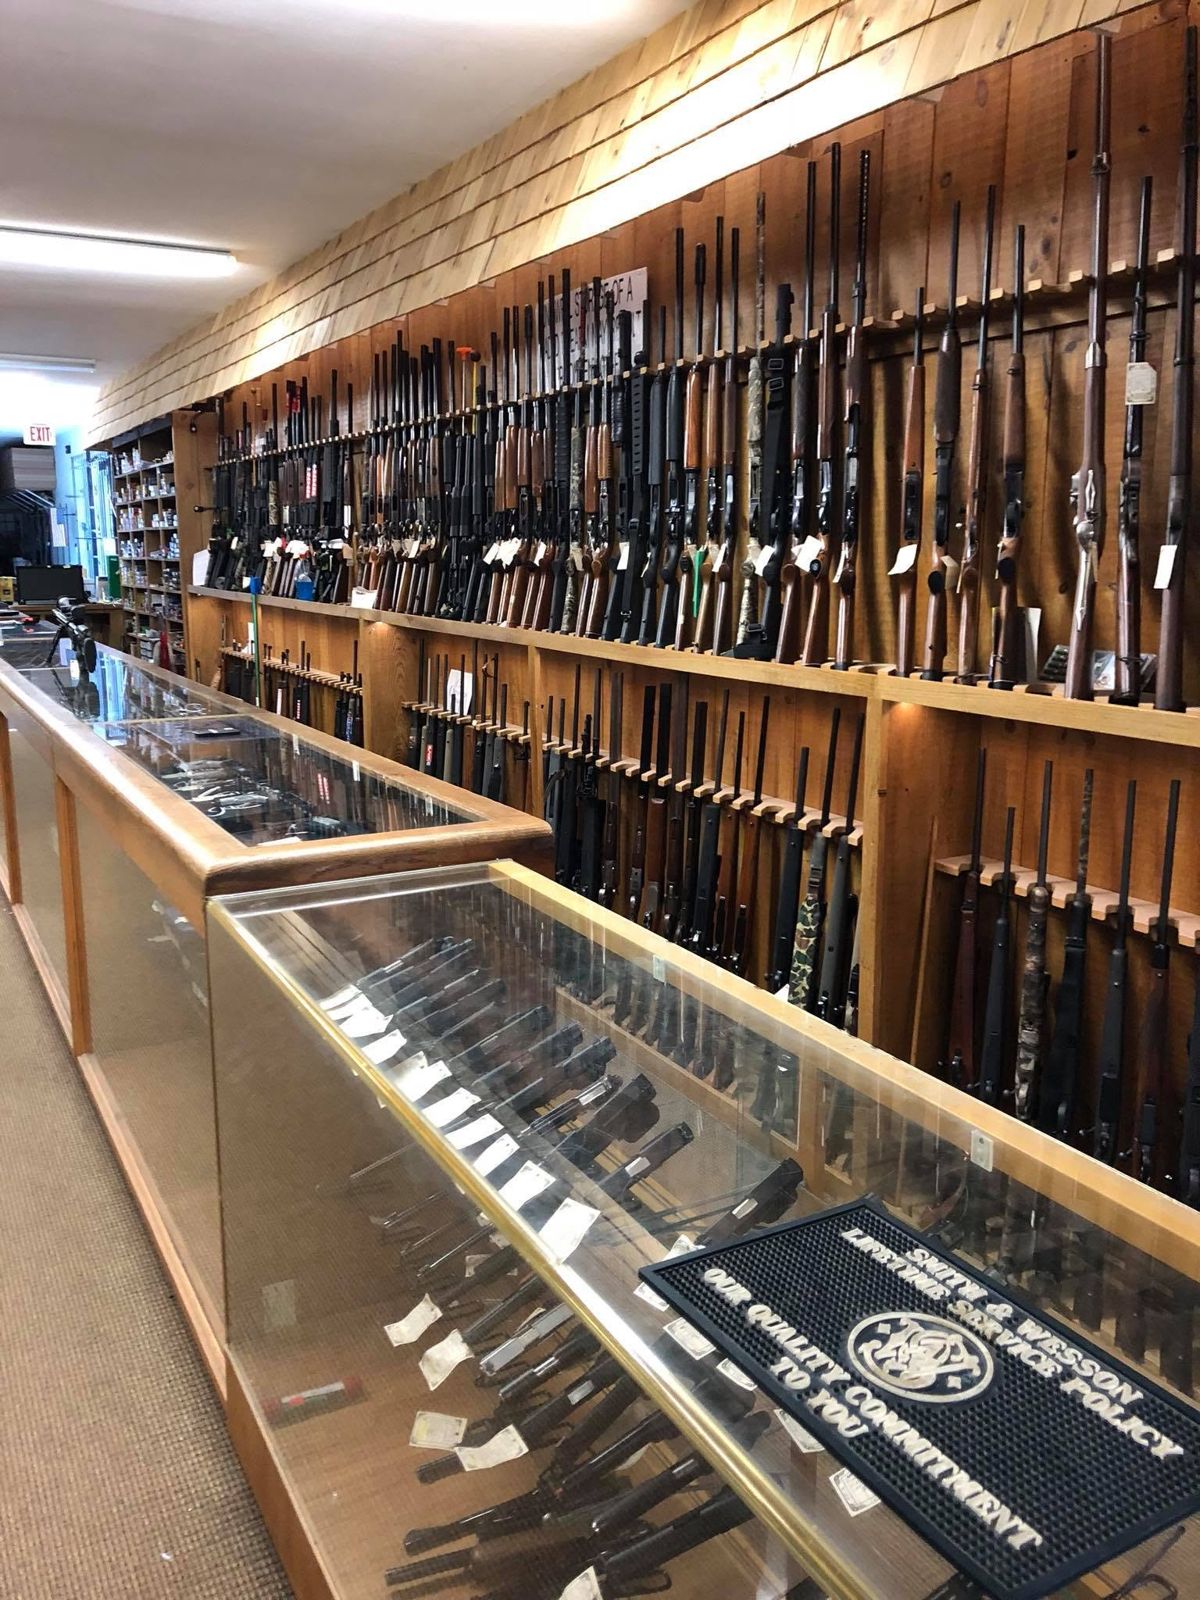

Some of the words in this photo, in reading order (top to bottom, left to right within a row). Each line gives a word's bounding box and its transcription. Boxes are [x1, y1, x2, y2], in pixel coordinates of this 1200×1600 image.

[30, 426, 50, 442] EXIT
[770, 1356, 811, 1390] TO
[807, 1388, 869, 1438] YOU
[841, 1227, 951, 1300] LIFETIME
[947, 1300, 1063, 1378] SERVICE
[1060, 1377, 1184, 1460] POLICY
[906, 1249, 988, 1301] SMITH
[986, 1303, 1012, 1320] &
[1017, 1319, 1143, 1405] WESSON
[704, 1268, 752, 1306] OUR
[747, 1304, 851, 1385] QUALITY
[845, 1386, 1043, 1550] COMMITMENT
